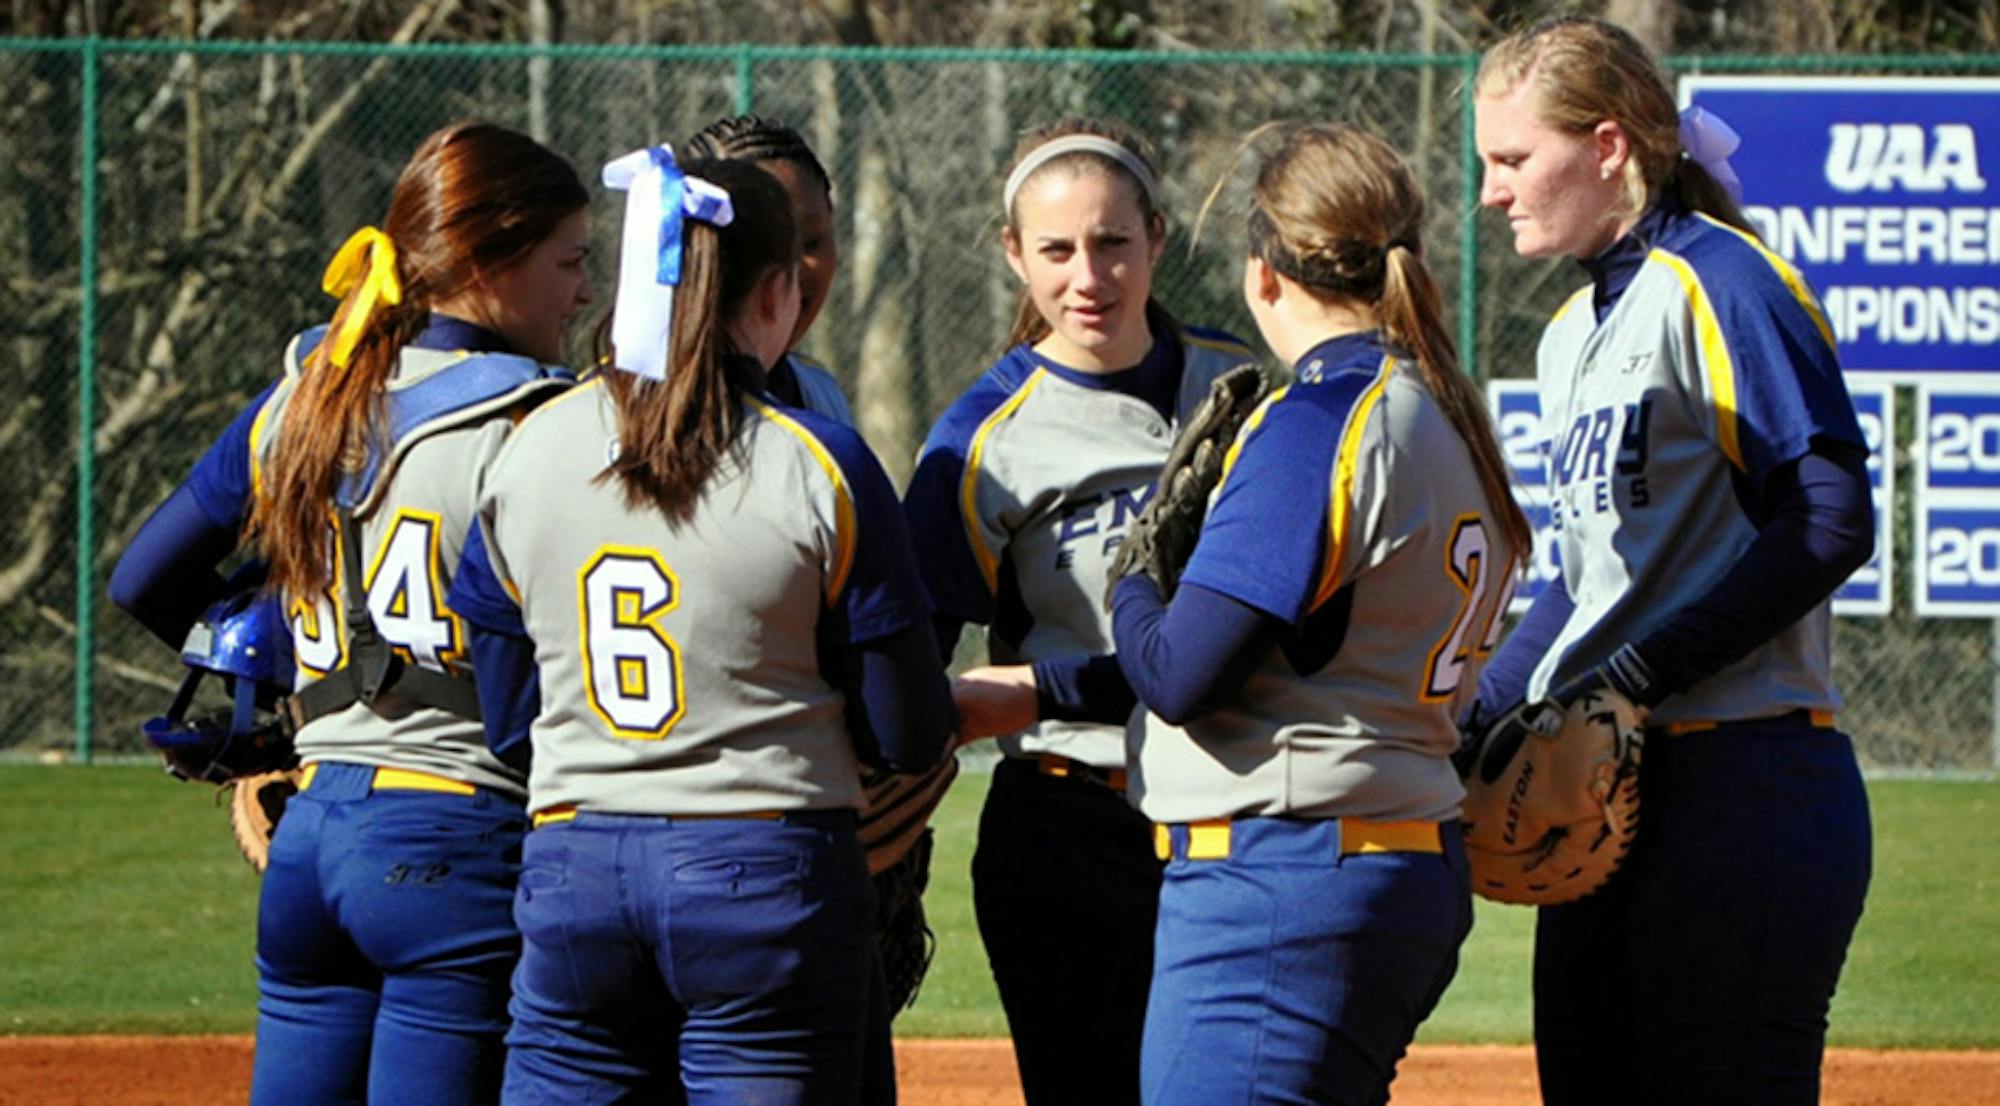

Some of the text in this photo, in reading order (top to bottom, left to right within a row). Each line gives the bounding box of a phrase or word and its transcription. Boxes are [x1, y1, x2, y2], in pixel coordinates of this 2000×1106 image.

[1825, 123, 1987, 192] UAA
[1742, 205, 2000, 265] ONFERE
[1930, 413, 2000, 472] 20
[1928, 527, 2000, 586] 20
[577, 543, 686, 741] 6
[1503, 760, 1534, 846] EASTON
